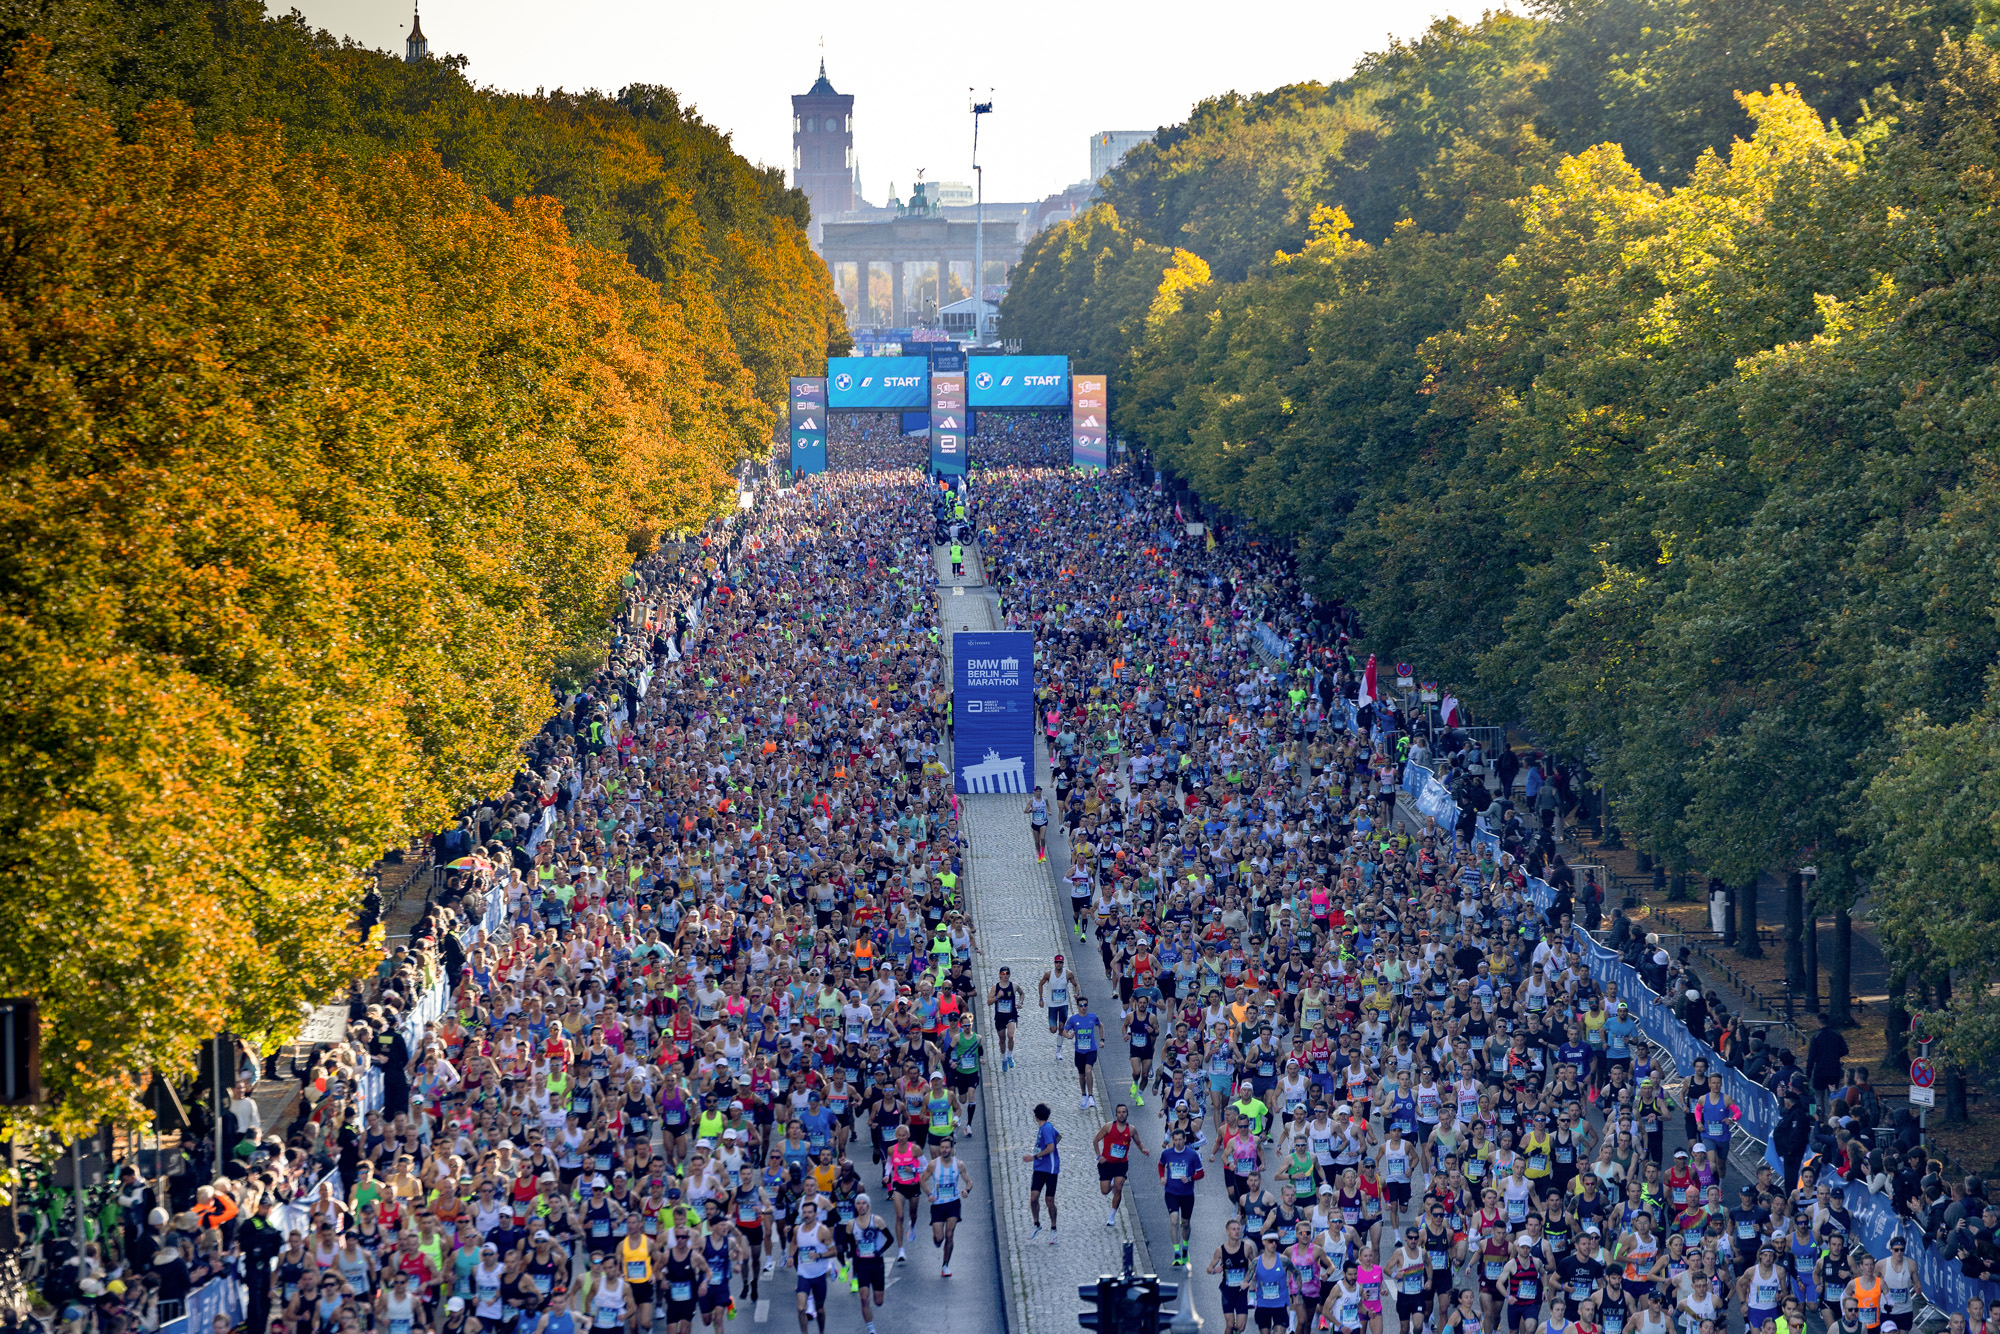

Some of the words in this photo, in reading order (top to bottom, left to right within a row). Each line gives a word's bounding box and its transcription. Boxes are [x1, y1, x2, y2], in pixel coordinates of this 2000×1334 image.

[883, 376, 921, 387] START
[1023, 375, 1061, 386] START
[967, 659, 999, 670] BMW
[967, 670, 1000, 678] BERLIN
[967, 678, 1019, 686] MARATHON
